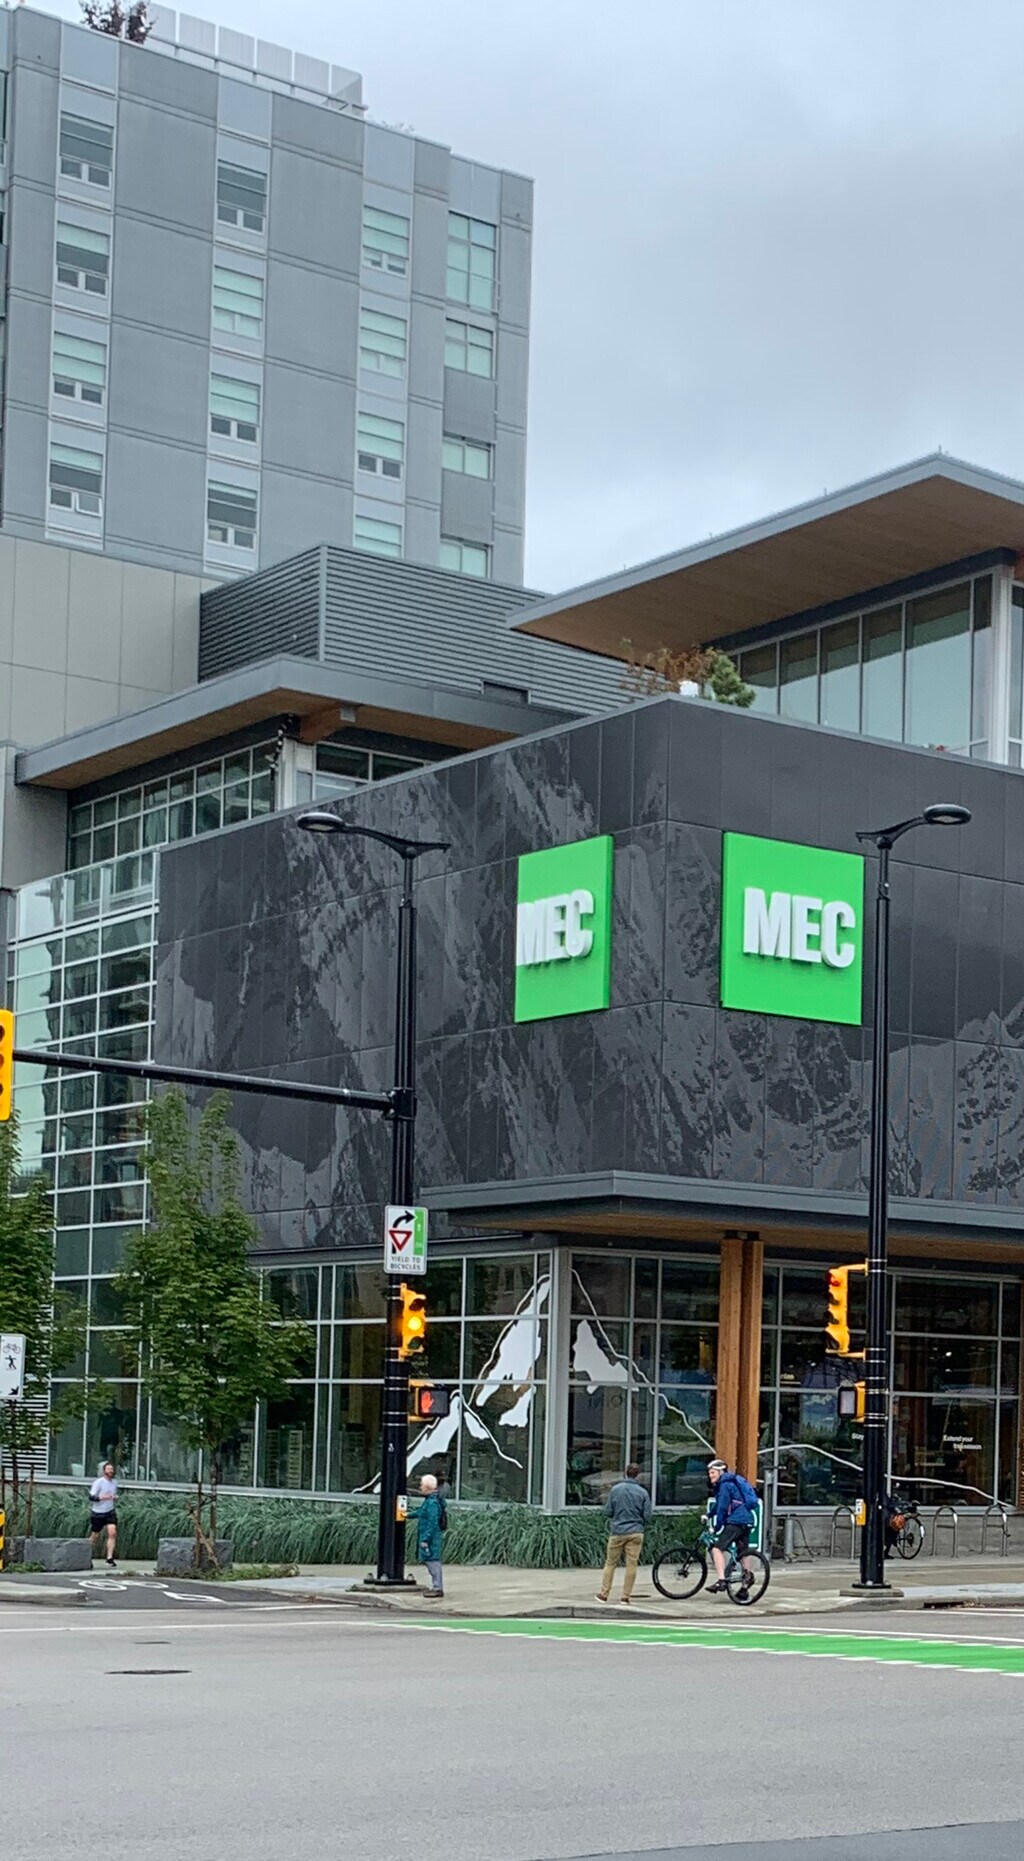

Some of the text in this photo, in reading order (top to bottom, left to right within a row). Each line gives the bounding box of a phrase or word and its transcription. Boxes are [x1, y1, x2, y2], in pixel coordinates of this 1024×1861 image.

[516, 889, 594, 967] MEC
[743, 887, 856, 968] MEC
[390, 1263, 421, 1271] BICYCLES
[391, 1255, 409, 1263] YIELD
